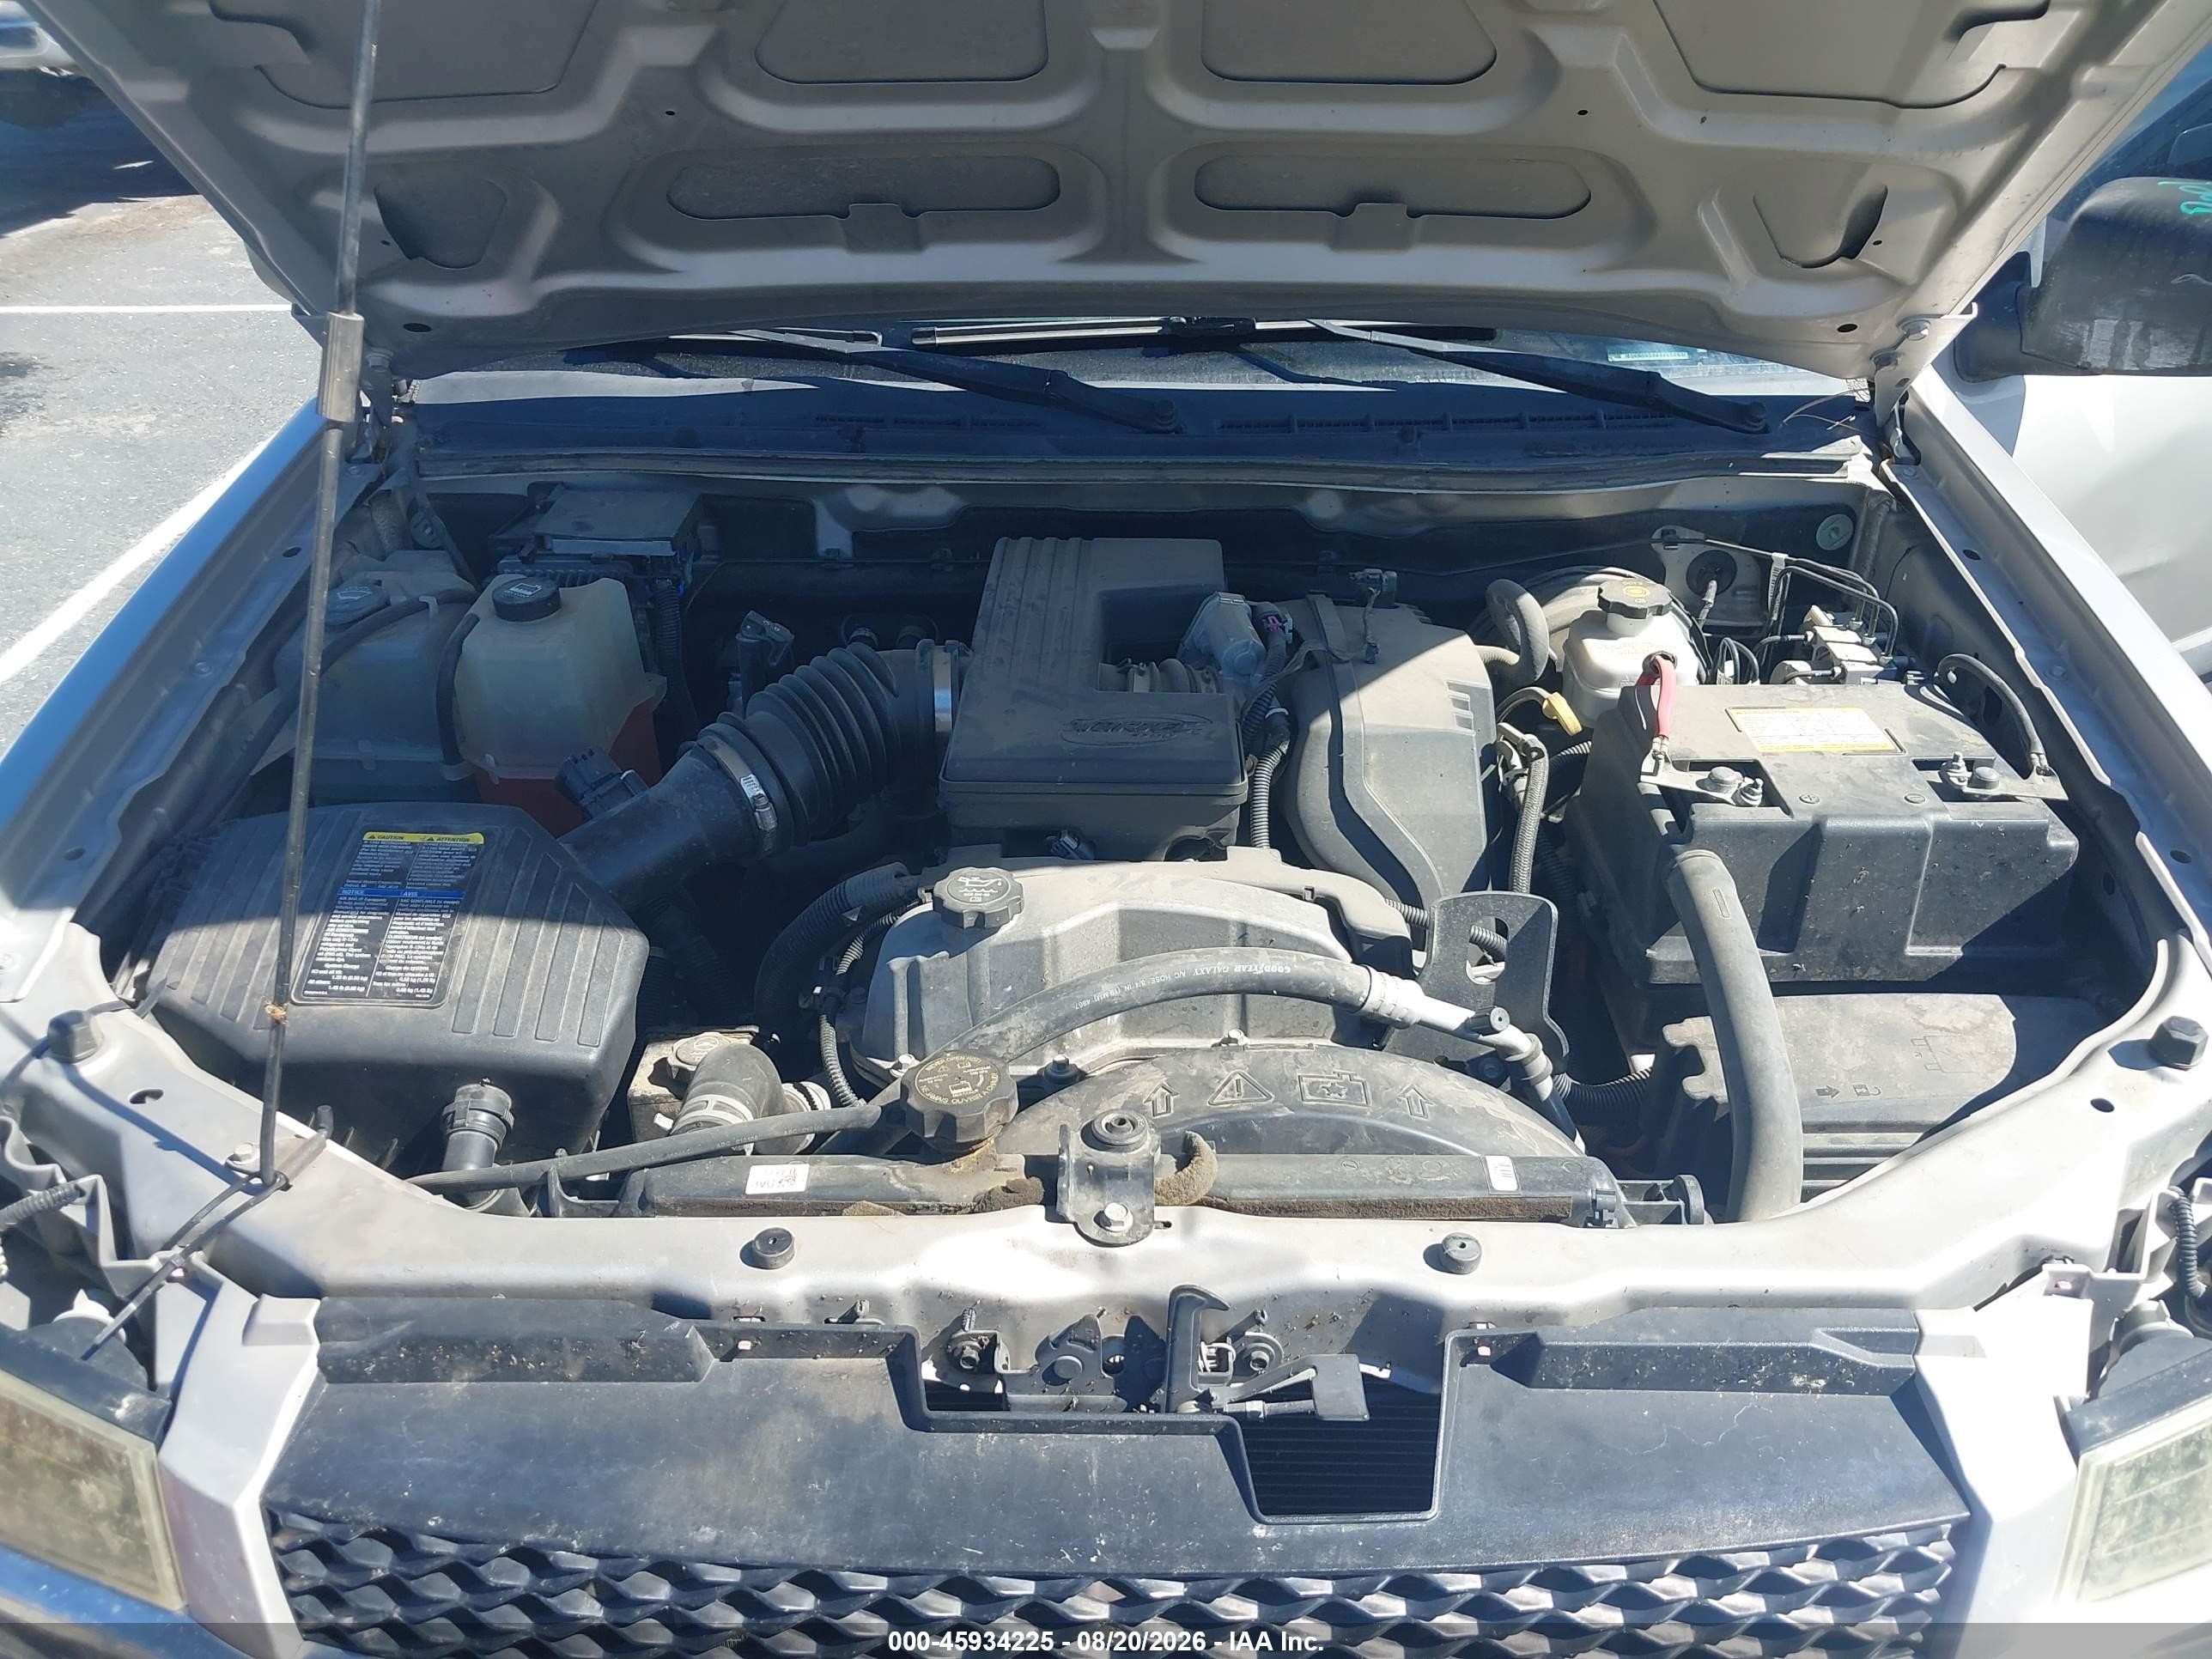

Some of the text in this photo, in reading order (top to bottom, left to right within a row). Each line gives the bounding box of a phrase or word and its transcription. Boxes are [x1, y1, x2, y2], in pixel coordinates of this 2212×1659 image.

[1173, 969, 1187, 980] A/C
[1191, 964, 1231, 976] GALAXY
[925, 1059, 945, 1071] NEVER
[951, 1093, 983, 1104] OUVRIR
